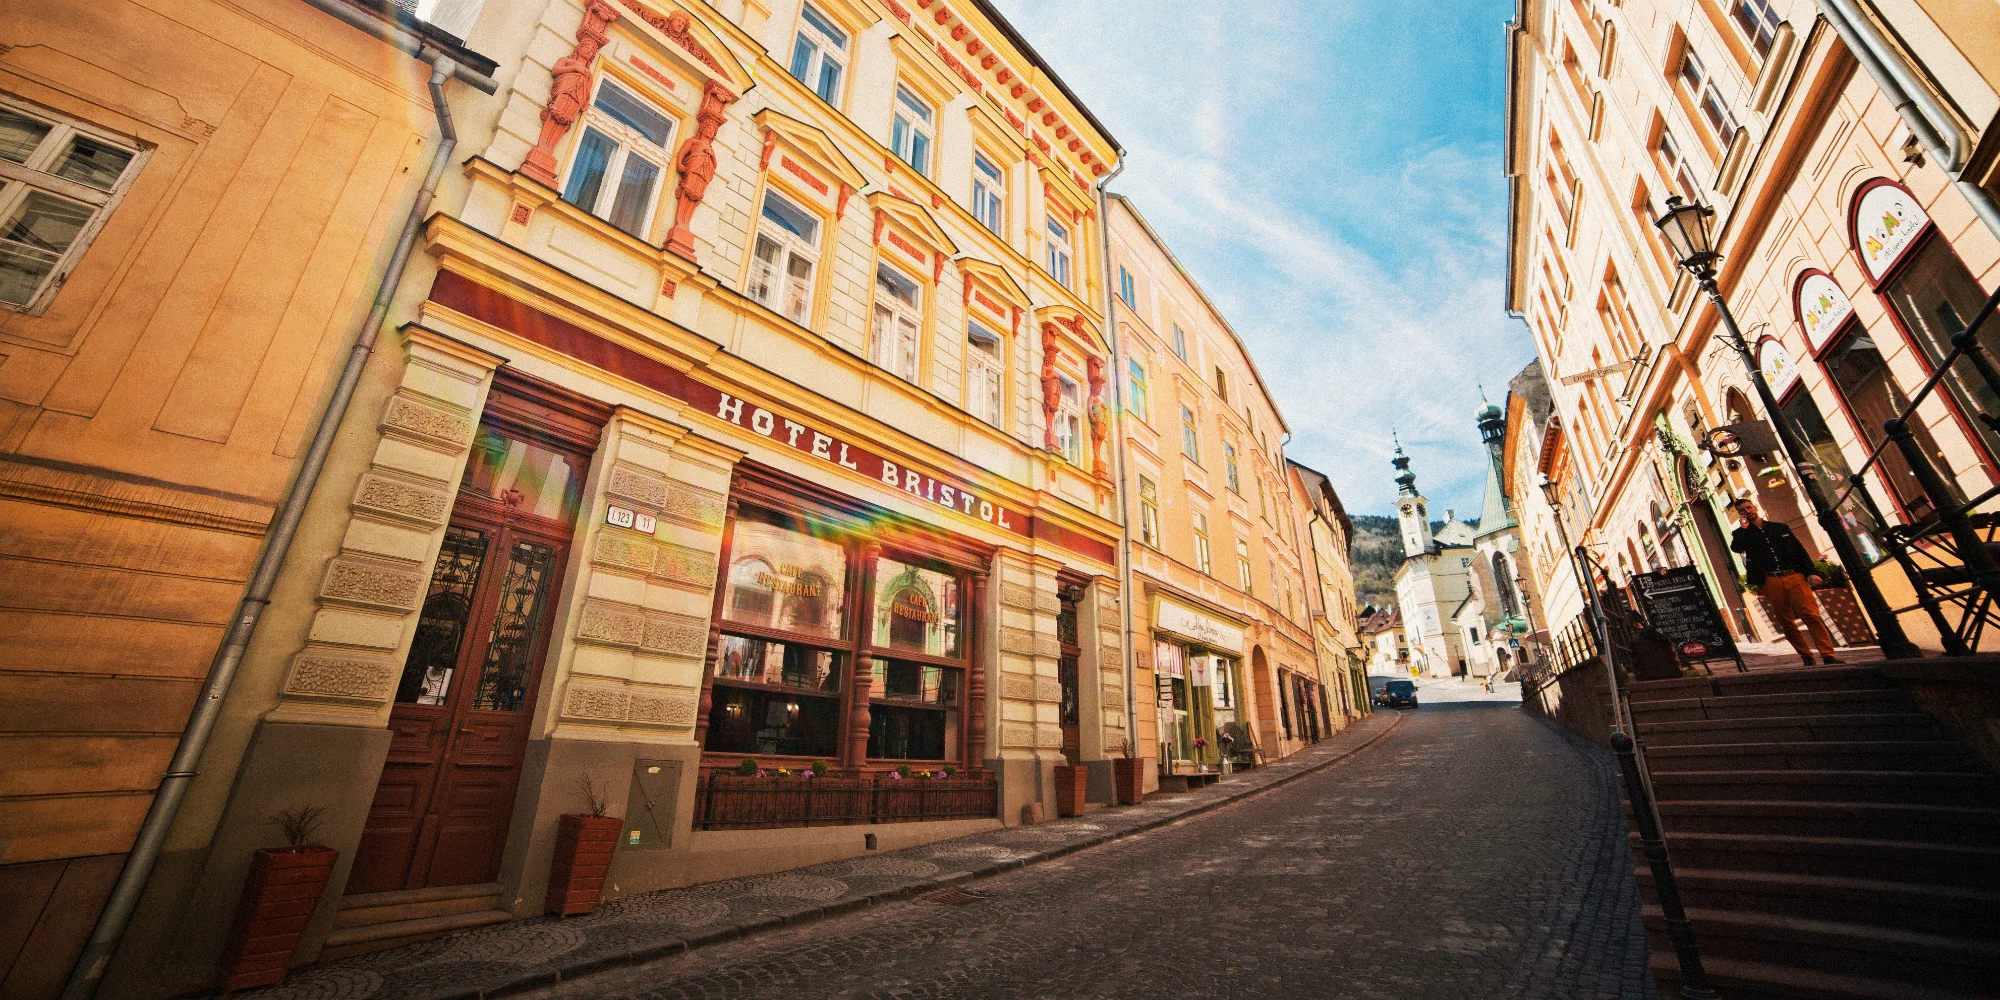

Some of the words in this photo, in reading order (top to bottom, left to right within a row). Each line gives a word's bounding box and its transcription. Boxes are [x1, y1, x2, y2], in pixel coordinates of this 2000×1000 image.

[716, 393, 857, 471] HOTEL
[881, 460, 1010, 530] BRISTOL
[758, 571, 821, 597] RESTAURANT
